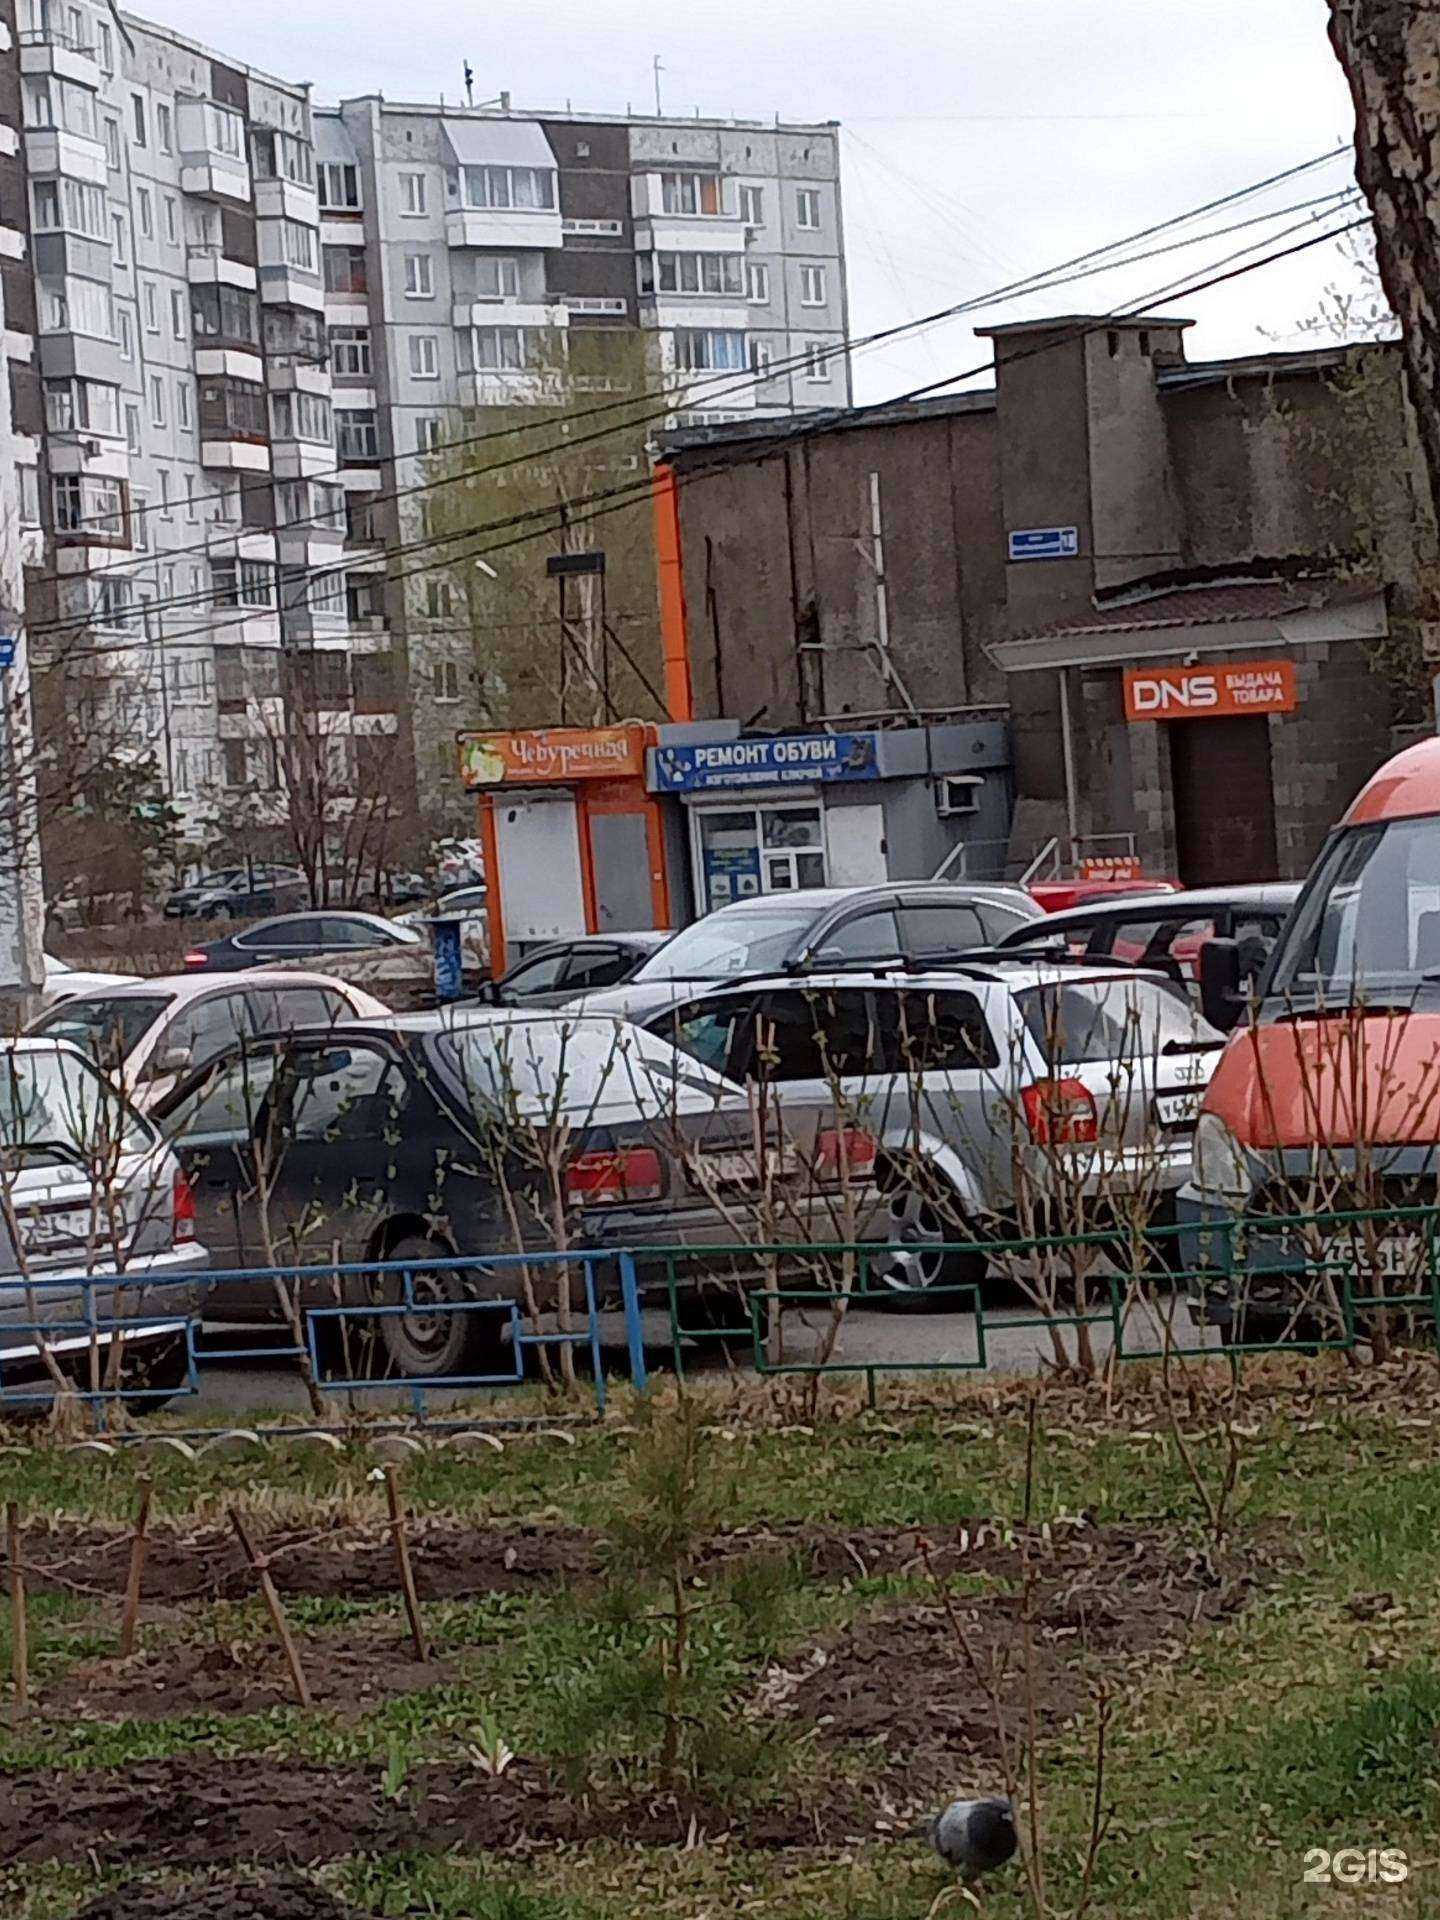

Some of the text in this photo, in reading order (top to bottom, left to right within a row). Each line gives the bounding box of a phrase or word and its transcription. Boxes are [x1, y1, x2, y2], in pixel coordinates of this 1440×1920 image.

[1225, 671, 1283, 690] ВЫДАЧА
[1133, 676, 1218, 710] DNS
[1232, 687, 1284, 705] ТОВАРА
[695, 738, 836, 768] РЕМОНТ ОБУВИ
